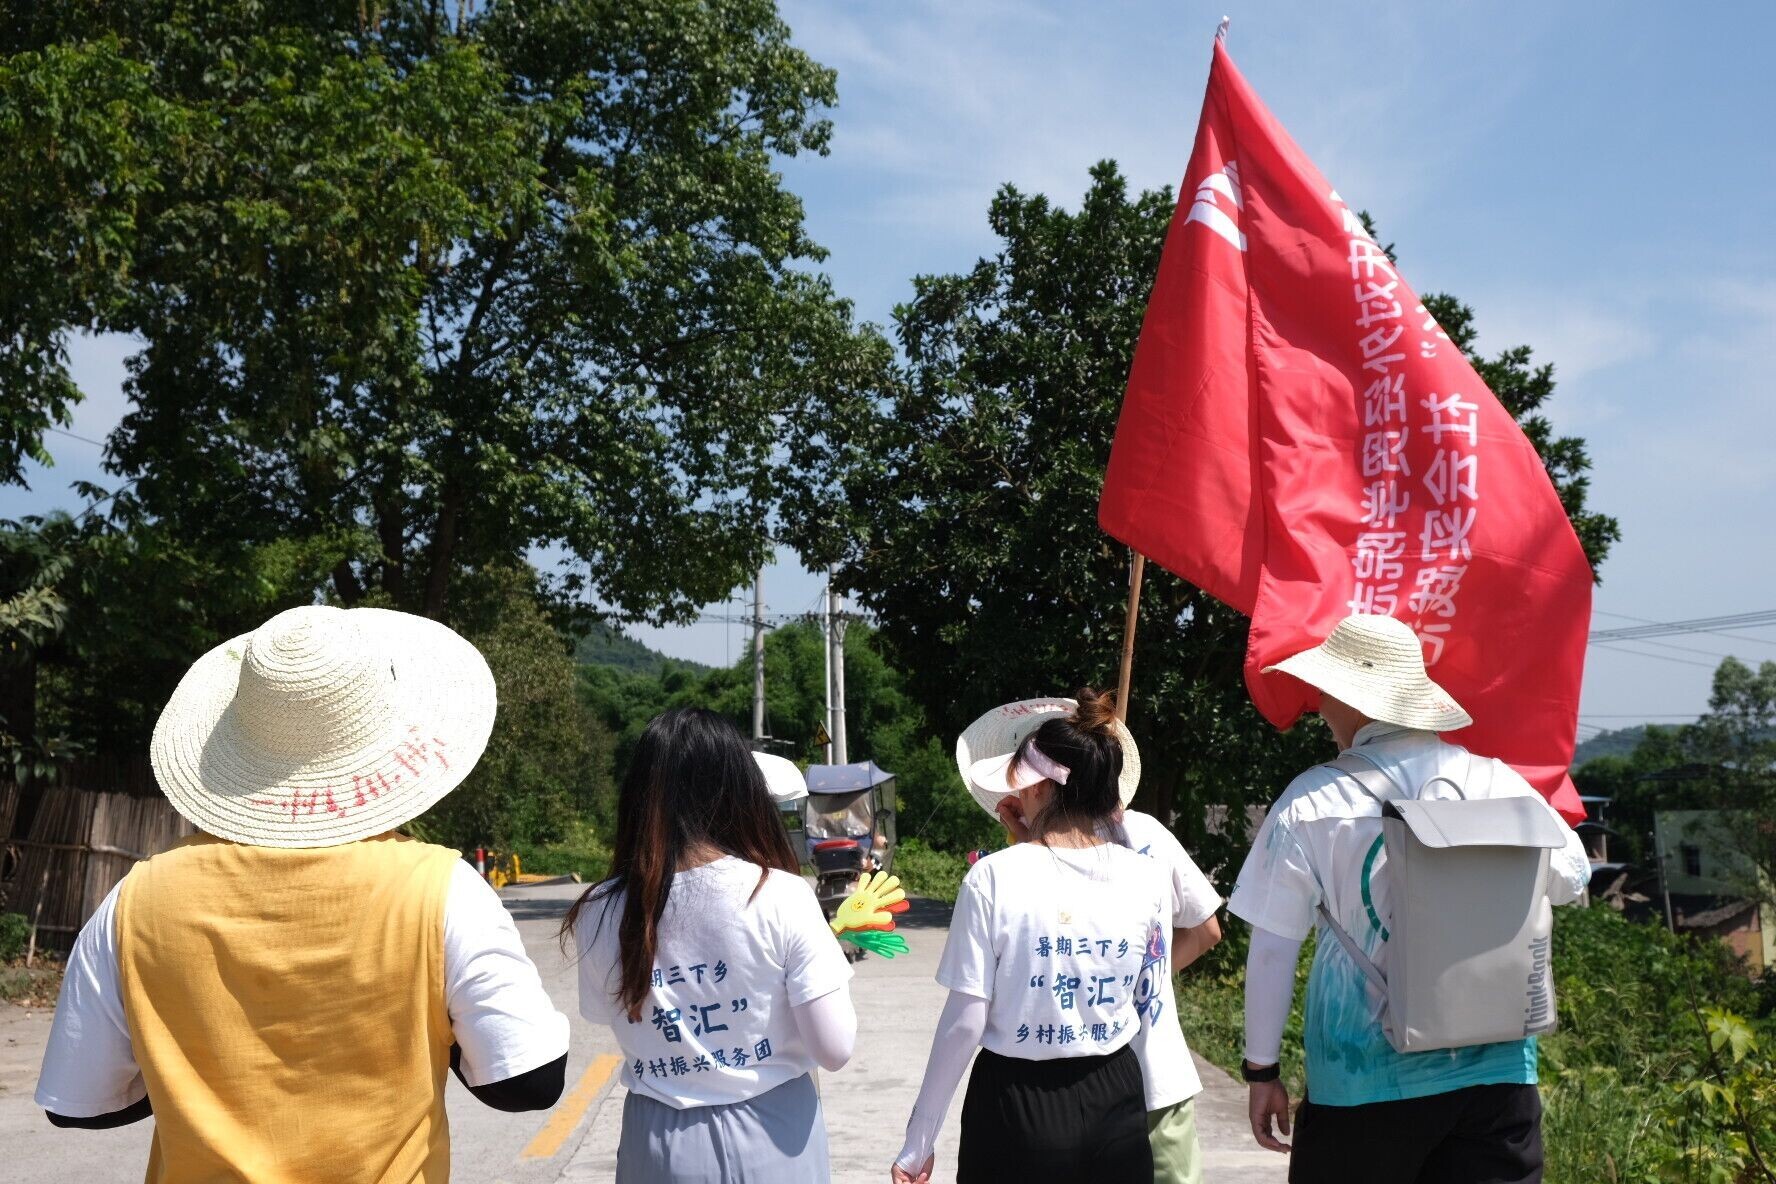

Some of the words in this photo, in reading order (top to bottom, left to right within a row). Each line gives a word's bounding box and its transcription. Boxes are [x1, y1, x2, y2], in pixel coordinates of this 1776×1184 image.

[1035, 936, 1129, 958] 暑期三下乡
[1523, 936, 1548, 1036] ThinkBook
[1016, 1017, 1130, 1045] 乡村振兴服务
[633, 1038, 772, 1079] 乡村振兴服务团
